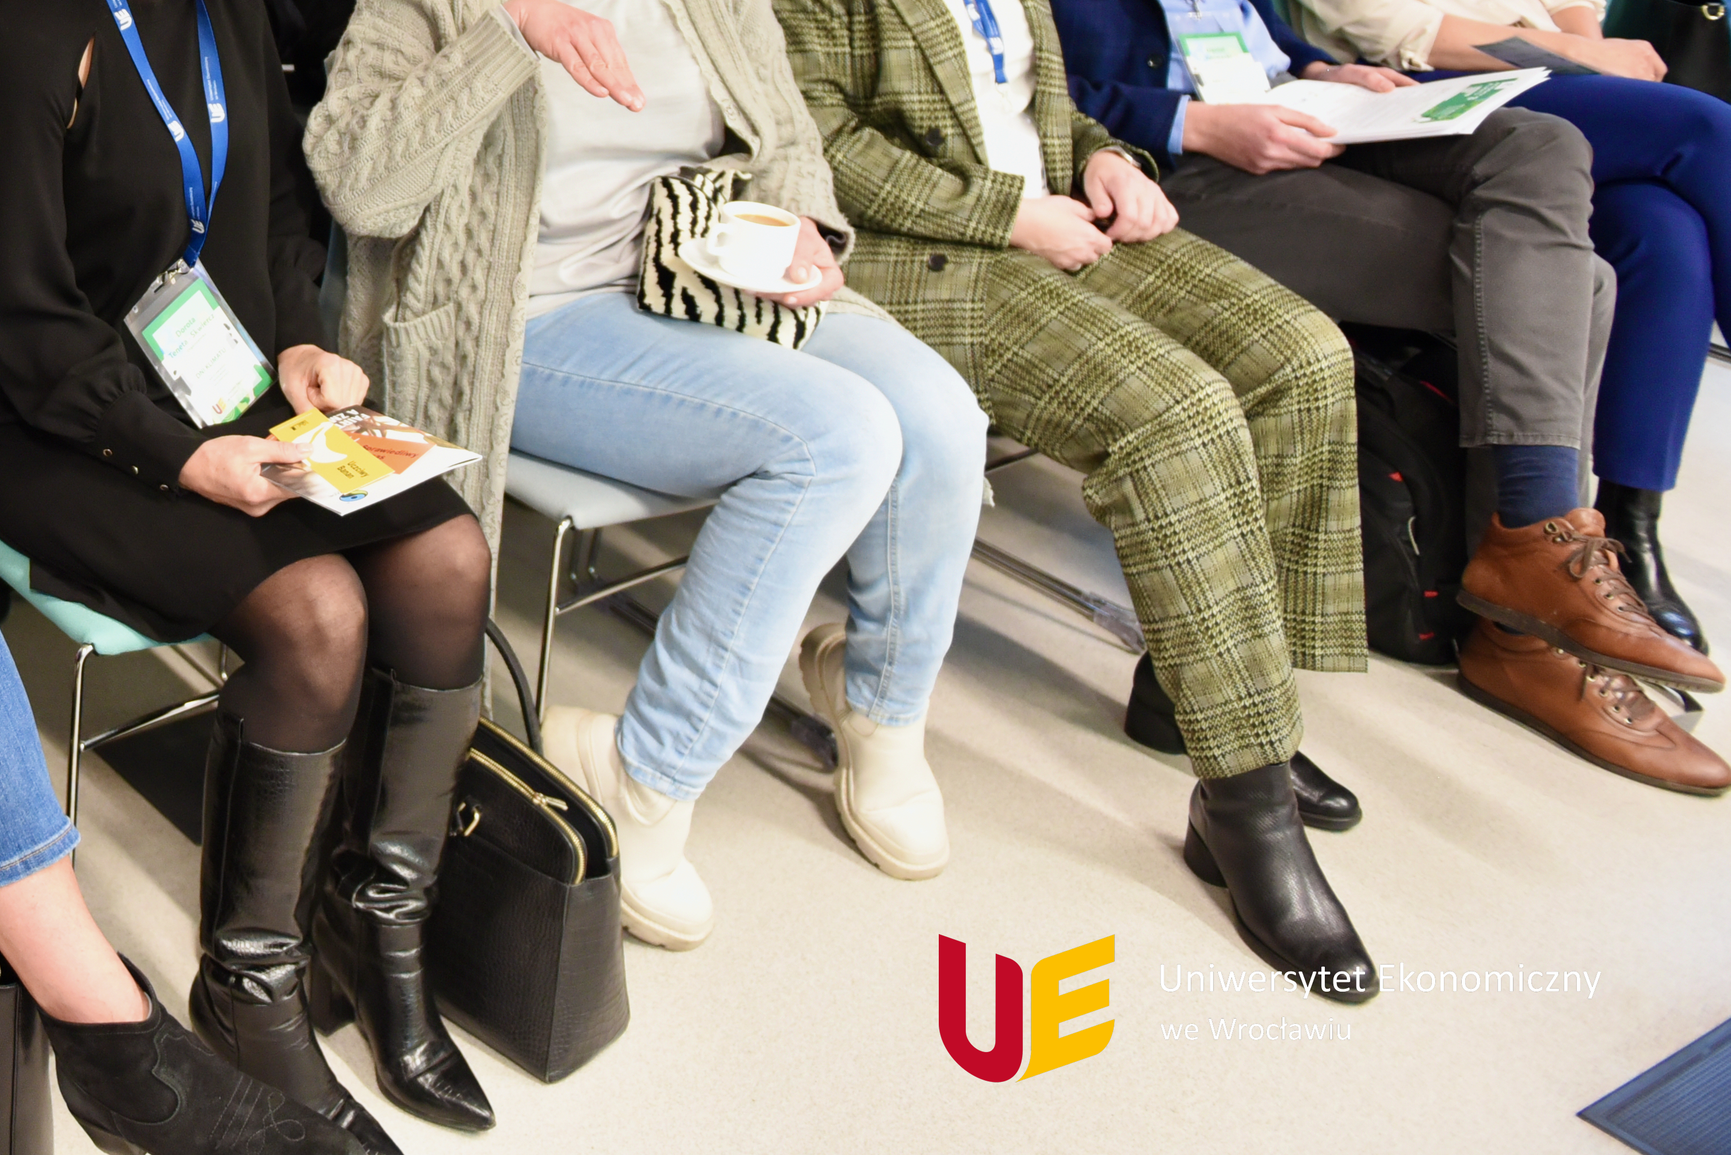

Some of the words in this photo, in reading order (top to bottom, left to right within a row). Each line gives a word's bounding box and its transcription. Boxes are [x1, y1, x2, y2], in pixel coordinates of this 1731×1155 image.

[176, 317, 196, 338] Dorota
[212, 398, 227, 415] UE
[334, 413, 370, 429] FAIRT
[337, 465, 355, 479] Banan
[347, 460, 369, 478] Uczciwy
